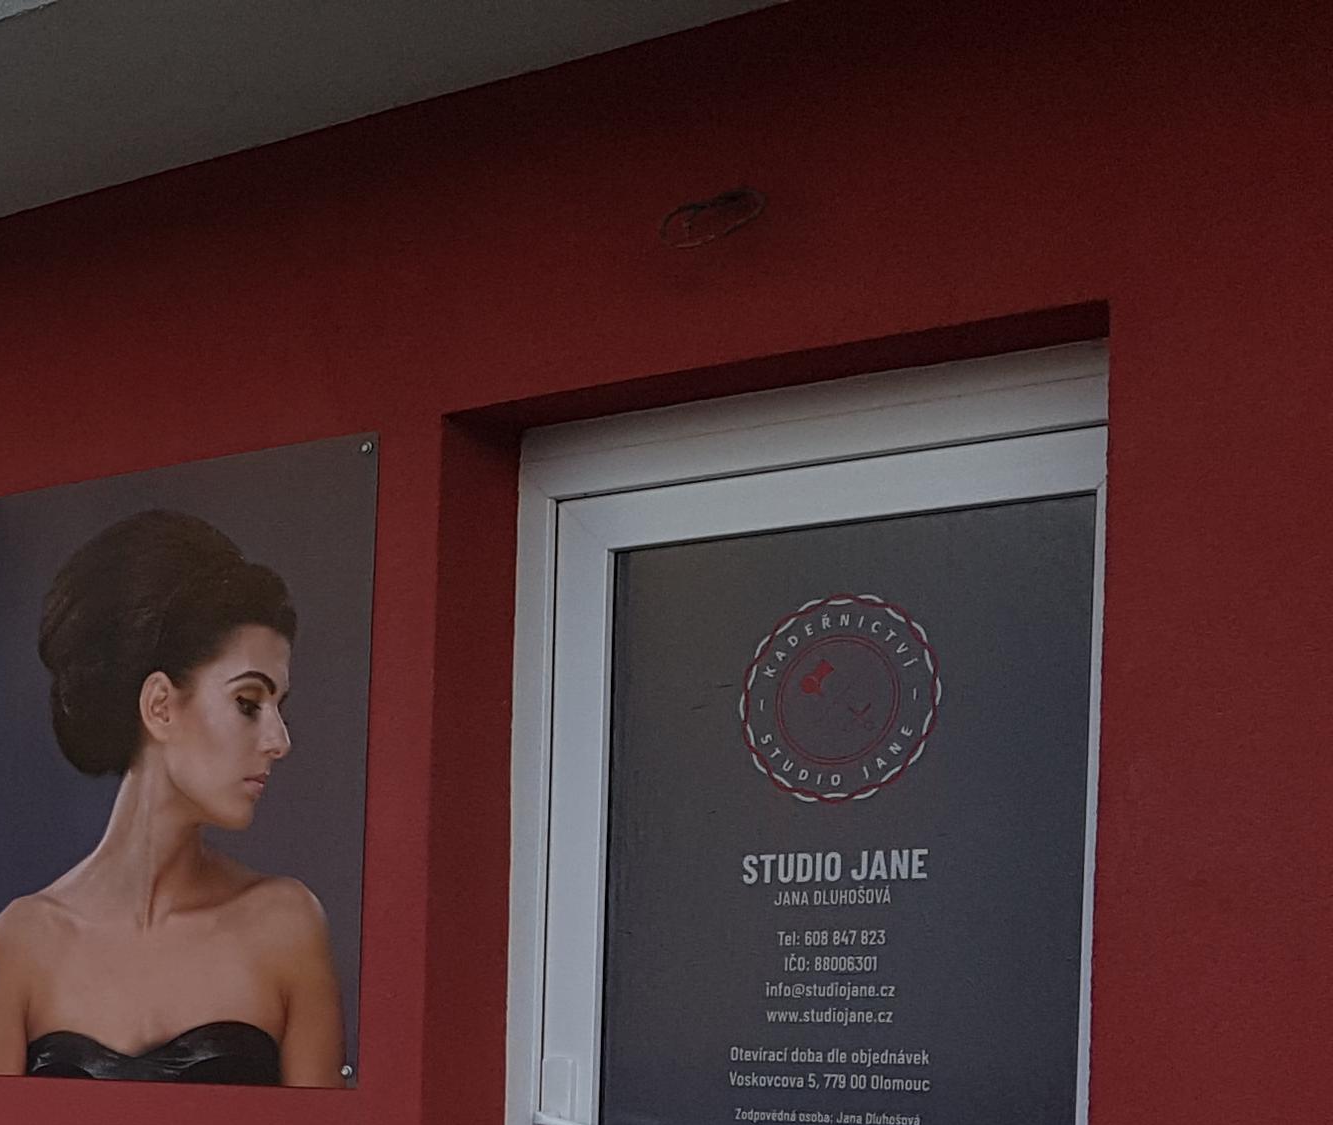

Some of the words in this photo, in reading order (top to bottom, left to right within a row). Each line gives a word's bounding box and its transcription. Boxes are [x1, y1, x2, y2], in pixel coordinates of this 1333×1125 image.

[763, 613, 919, 678] KADEŘNICTVÍ
[760, 733, 841, 786] STUDIO
[862, 725, 914, 779] JANE
[742, 852, 842, 885] STUDIO
[851, 848, 928, 881] JANE
[774, 890, 809, 906] JANA
[813, 885, 892, 905] DLUHOŠOVÁ
[777, 930, 800, 946] Tel:
[804, 930, 829, 946] 608
[833, 930, 857, 945] 847
[860, 929, 886, 945] 823
[784, 953, 810, 972] IČO:
[814, 956, 878, 972] 88006301
[765, 982, 895, 1000] info@studiojane.cz
[766, 1008, 894, 1026] www.studiojane.cz
[730, 1046, 788, 1062] Otevírací
[791, 1047, 823, 1063] doba
[827, 1048, 847, 1064] dle
[851, 1049, 930, 1067] objednávek
[729, 1071, 804, 1088] Voskovcova
[807, 1073, 820, 1090] 5,
[824, 1073, 846, 1089] 779
[850, 1074, 867, 1089] 00
[871, 1074, 931, 1092] Olomouc
[836, 1112, 863, 1125] Jana
